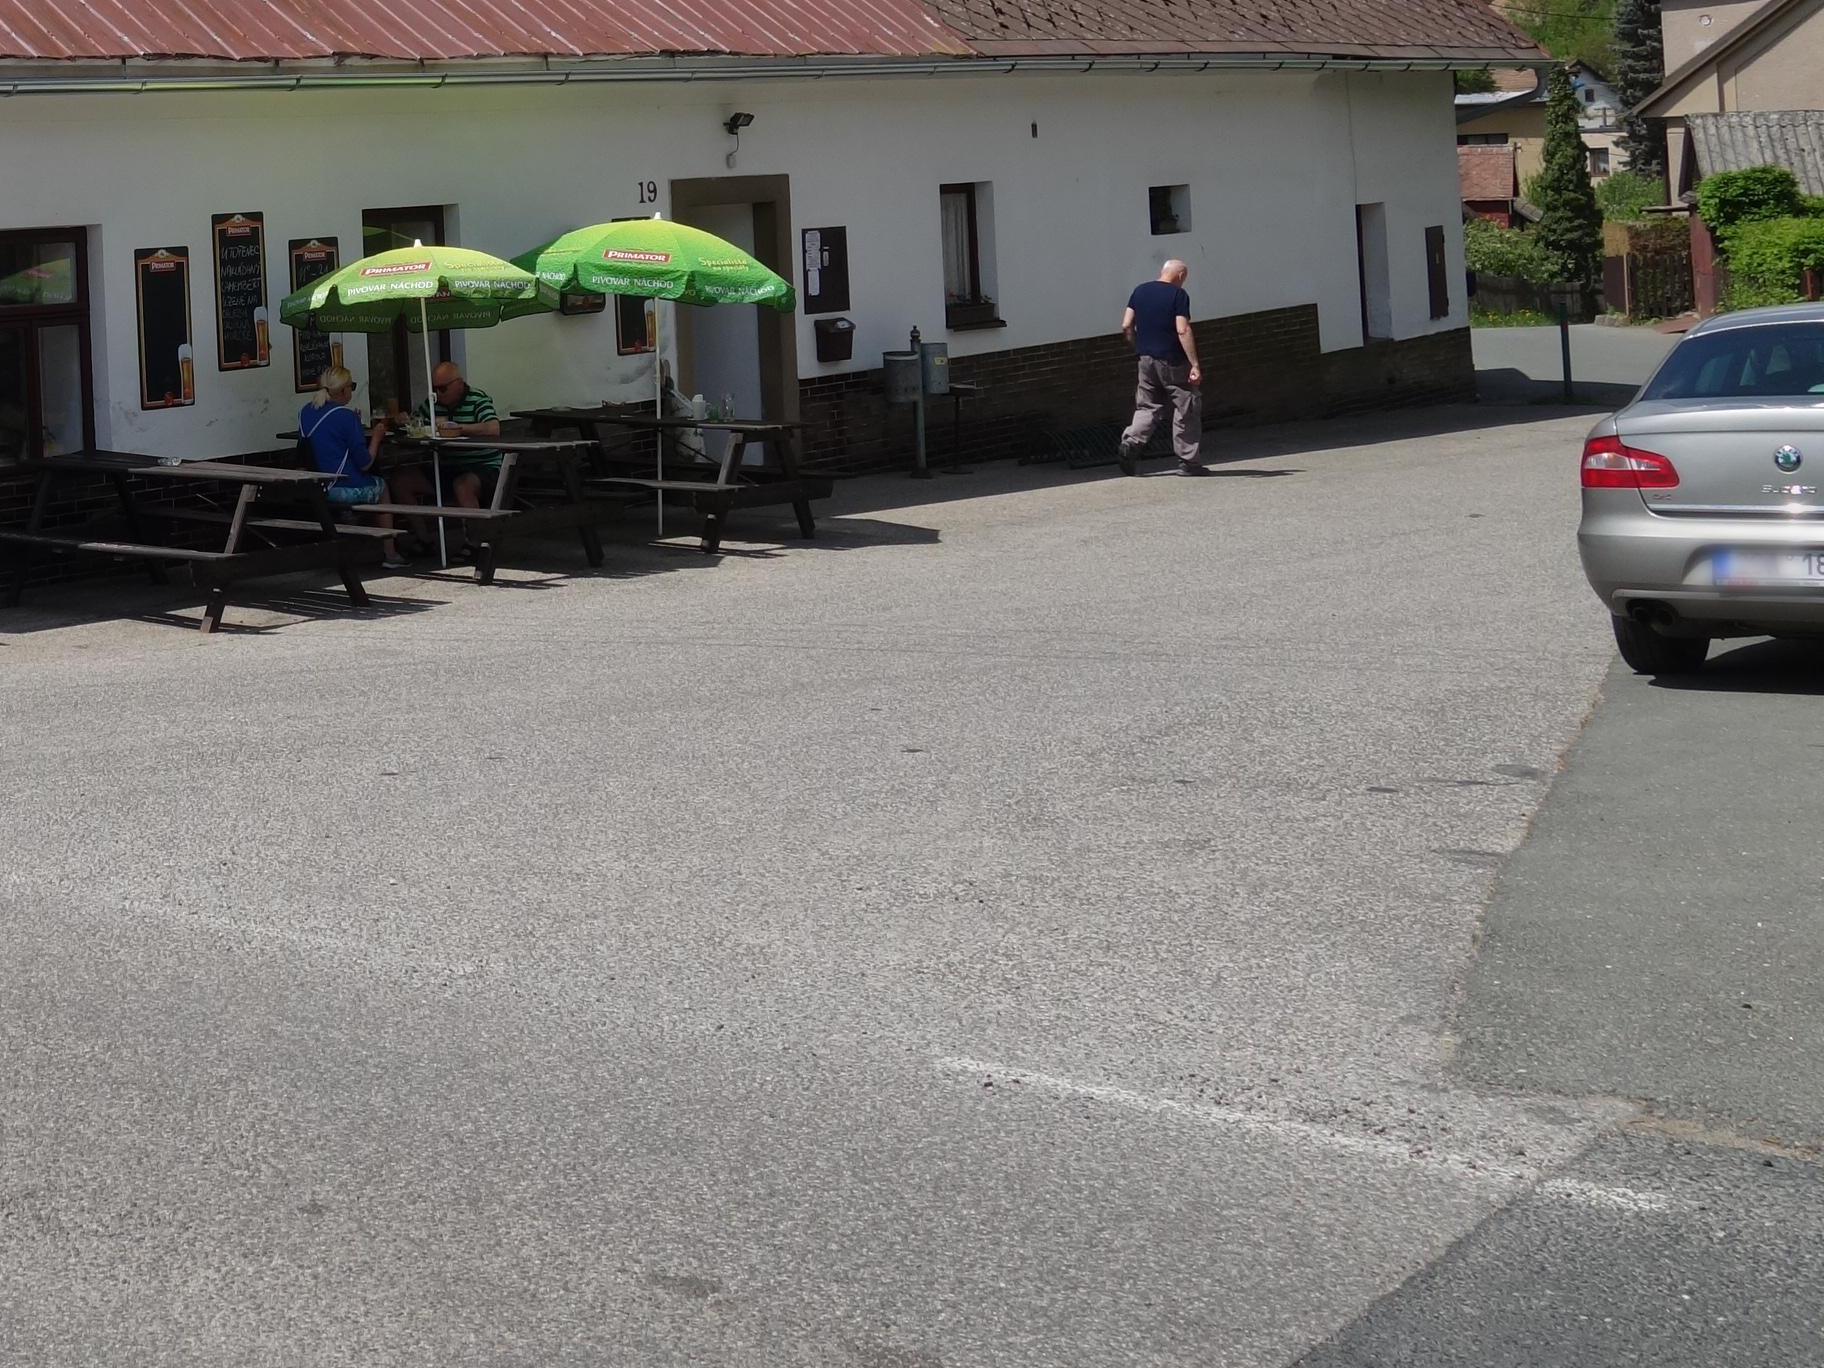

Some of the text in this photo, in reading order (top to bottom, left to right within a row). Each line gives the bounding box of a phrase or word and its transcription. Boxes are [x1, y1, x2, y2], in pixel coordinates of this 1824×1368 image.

[638, 181, 657, 203] 19
[608, 250, 666, 262] PRIMATOR
[365, 263, 426, 275] PRIMATOR
[347, 281, 433, 296] PIVOVAR NÁCHOD
[455, 280, 490, 288] PIVOVAR
[592, 276, 674, 289] PIVOVAR NÁCHOD
